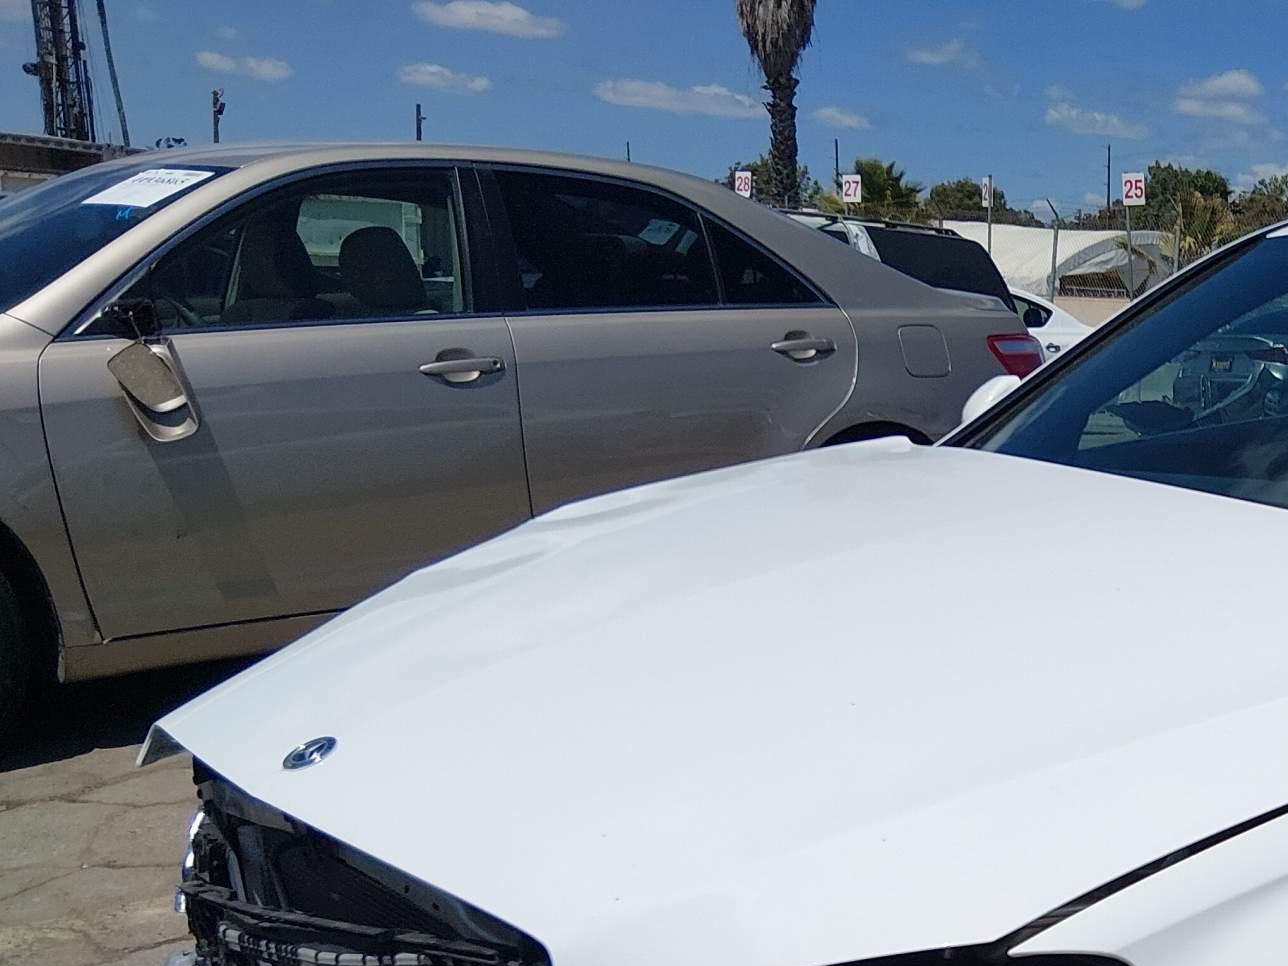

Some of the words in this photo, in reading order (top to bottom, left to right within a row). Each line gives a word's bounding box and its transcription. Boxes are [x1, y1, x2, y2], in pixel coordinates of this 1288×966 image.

[736, 176, 750, 192] 28
[844, 180, 859, 197] 27
[1124, 179, 1143, 199] 25
